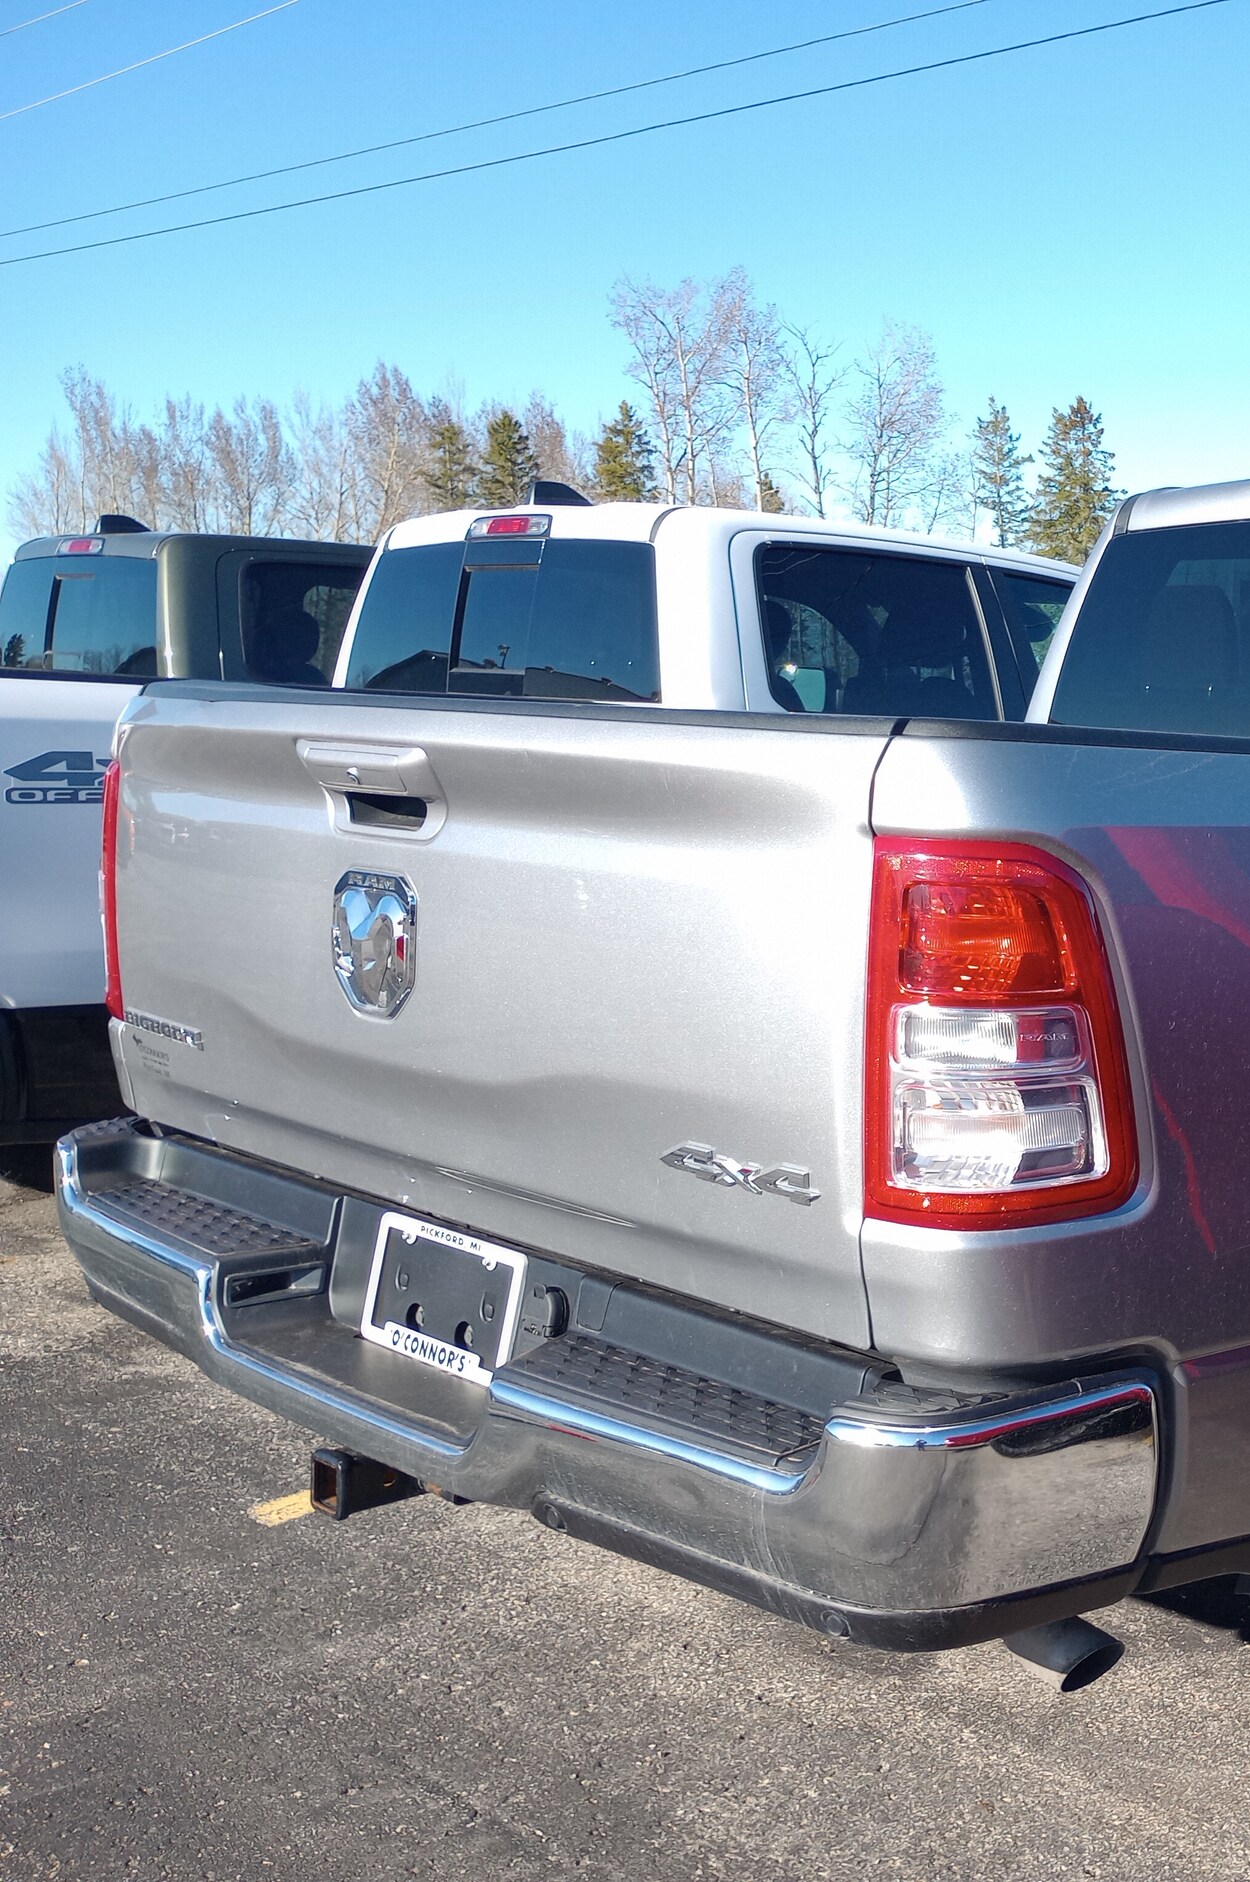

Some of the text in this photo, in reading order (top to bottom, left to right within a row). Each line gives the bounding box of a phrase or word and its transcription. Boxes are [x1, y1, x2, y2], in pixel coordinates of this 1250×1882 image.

[10, 789, 104, 802] OFF
[347, 872, 396, 890] RAM
[470, 1242, 482, 1252] MI
[391, 1328, 466, 1373] O'CONNOR'S
